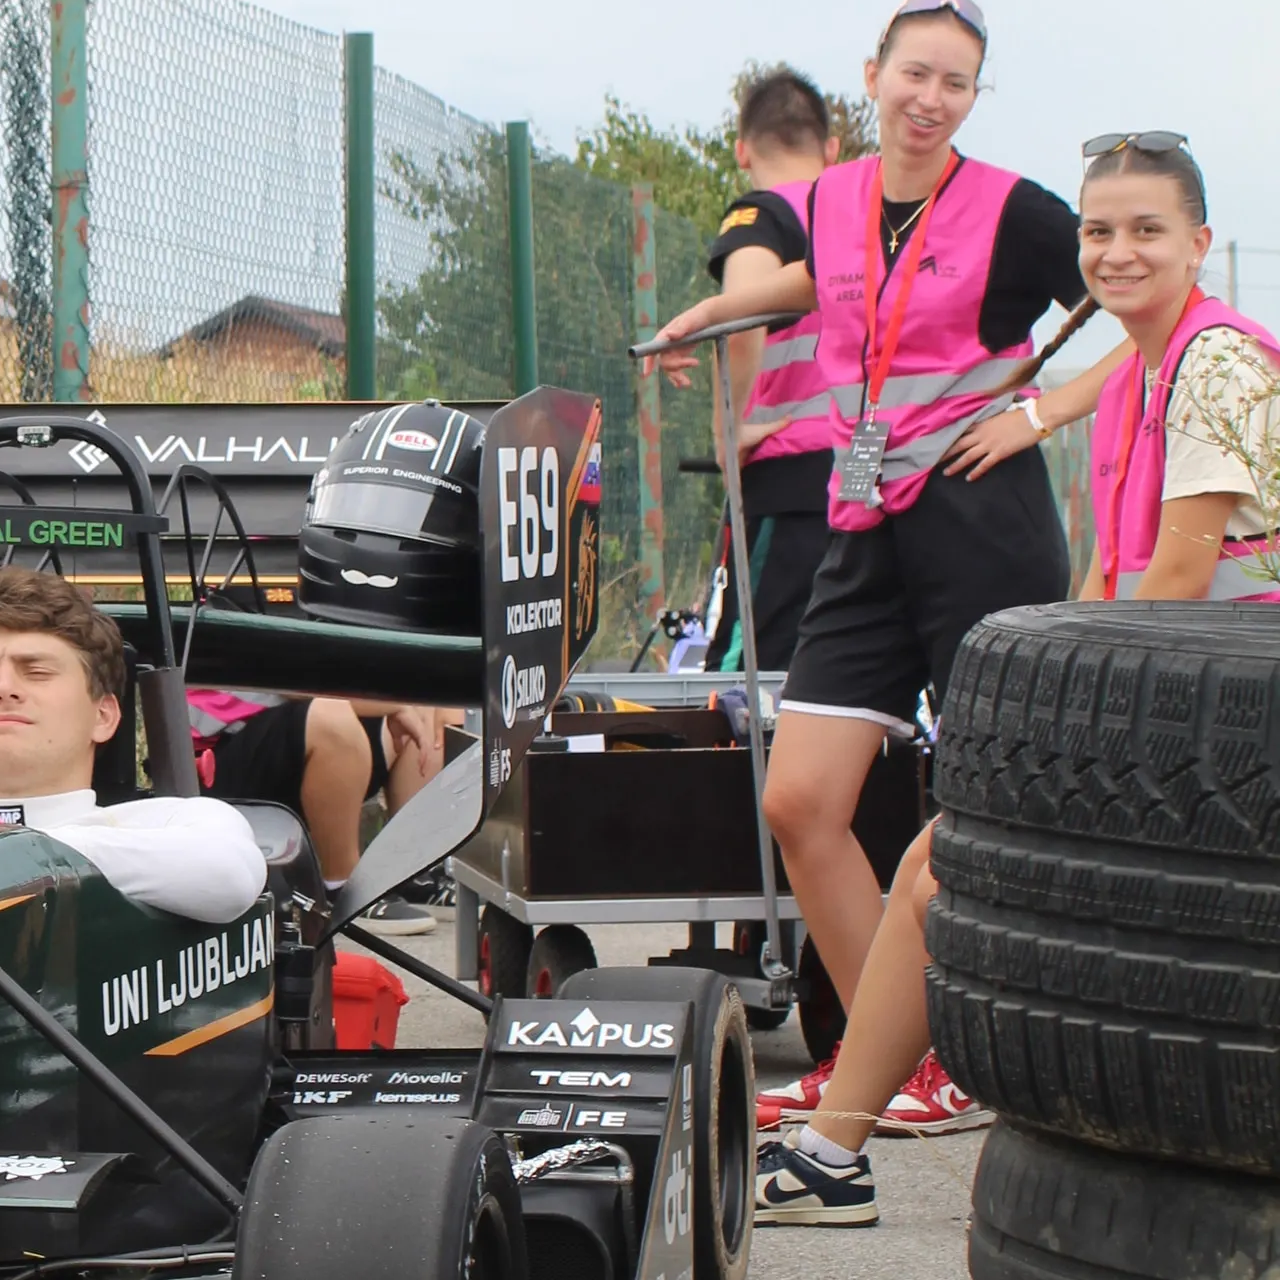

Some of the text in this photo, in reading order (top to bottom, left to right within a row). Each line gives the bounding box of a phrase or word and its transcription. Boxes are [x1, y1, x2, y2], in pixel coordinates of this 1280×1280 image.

[827, 272, 864, 287] DYNAM
[134, 435, 338, 462] VALHAL
[394, 434, 432, 446] BELL
[343, 466, 463, 494] SUPERIOR ENGINEERING
[496, 446, 560, 582] E69
[28, 521, 123, 547] GREEN
[506, 598, 562, 636] KOLEKTOR
[102, 910, 275, 1036] UNI LJUBLJAN
[530, 1070, 632, 1087] TEM
[575, 1111, 628, 1127] FE
